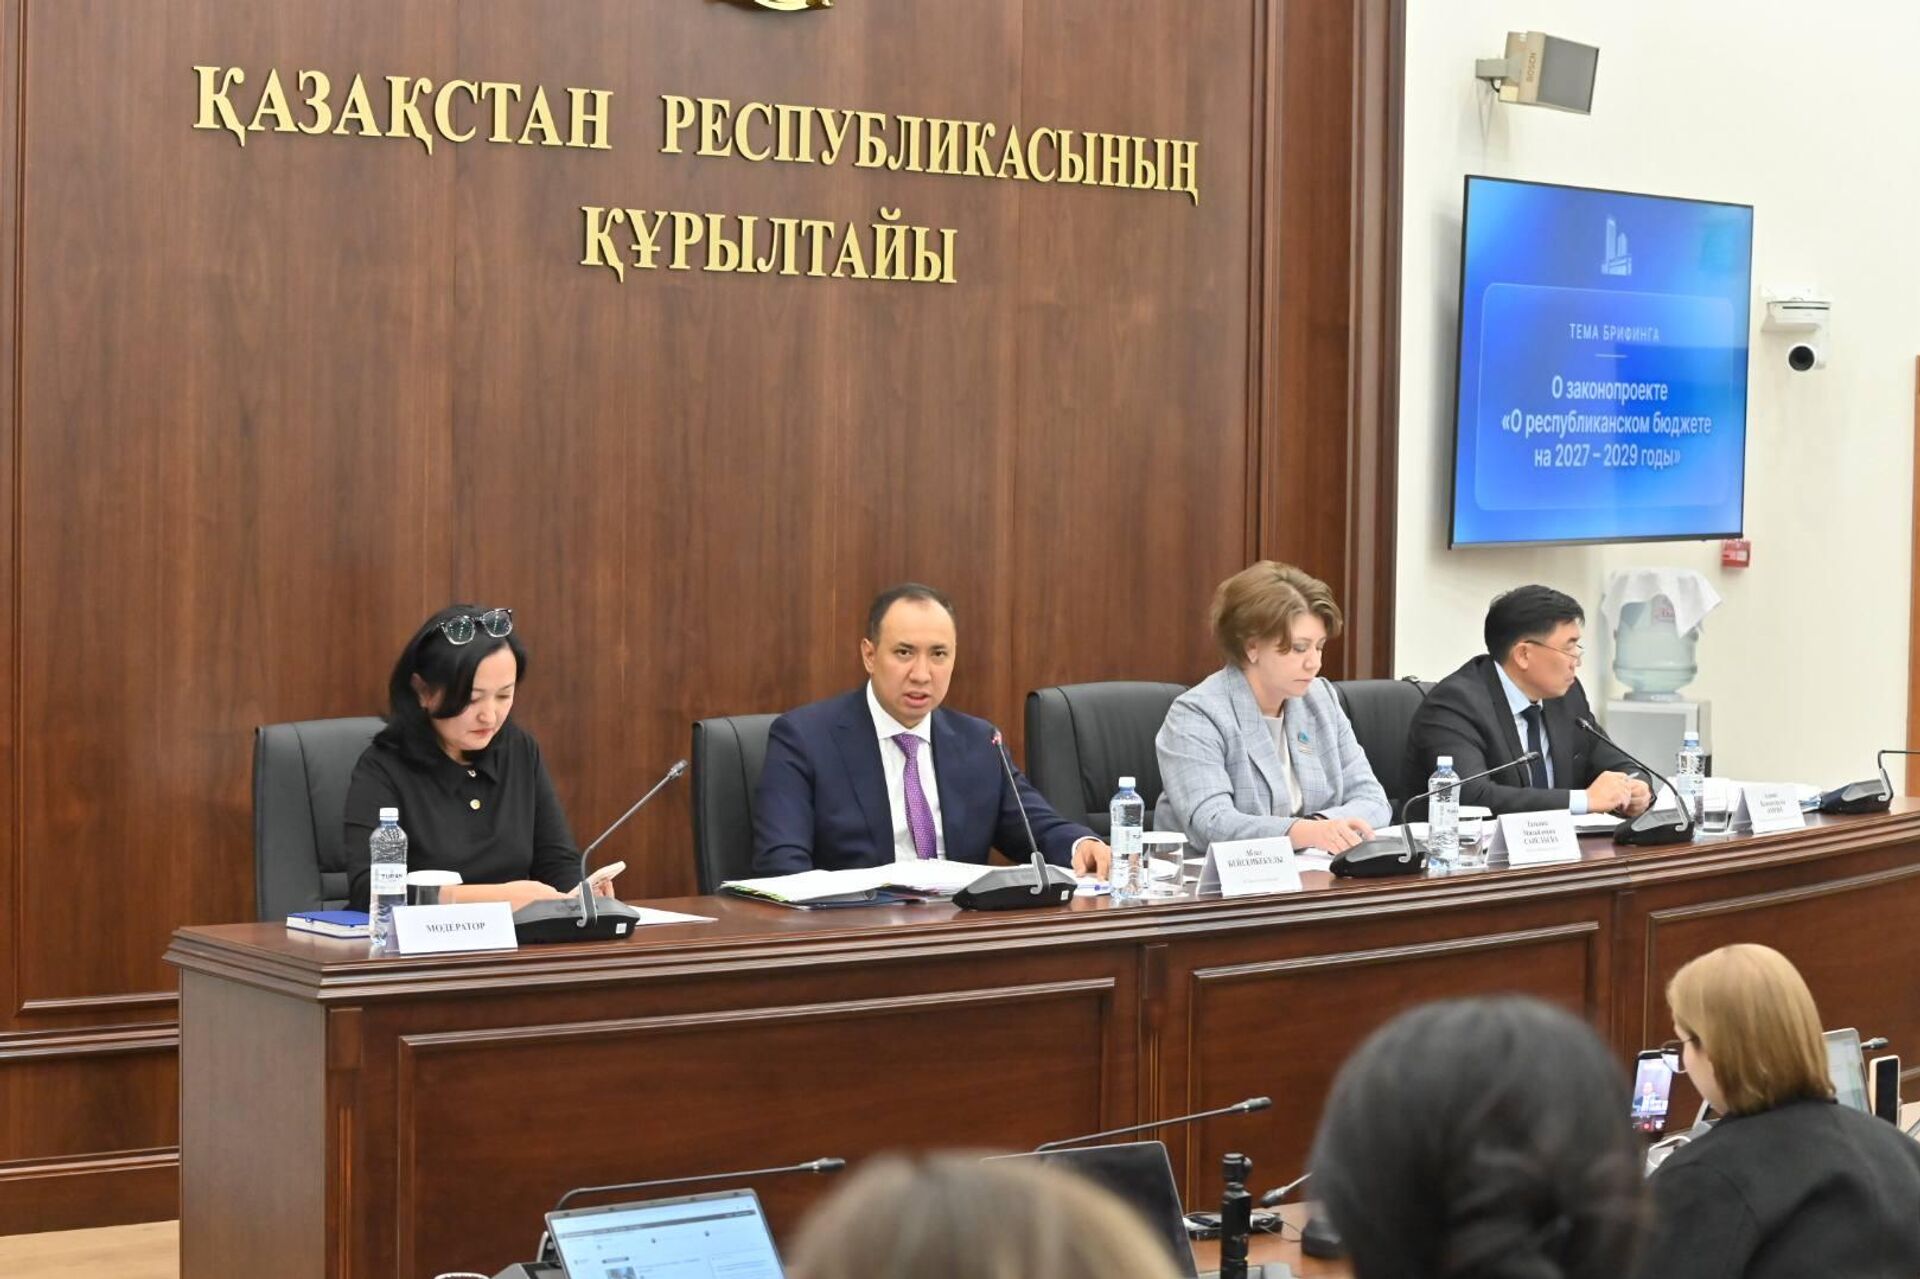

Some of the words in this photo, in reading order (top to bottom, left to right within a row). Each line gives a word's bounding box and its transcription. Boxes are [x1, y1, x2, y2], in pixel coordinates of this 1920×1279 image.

[193, 65, 614, 156] ҚАЗАҚСТАН
[660, 94, 1199, 206] РЕСПУБЛИКАСЫНЫҢ
[580, 206, 958, 285] ҚҰРЫЛТАЙЫ
[1569, 323, 1599, 340] ТЕМА
[1603, 324, 1660, 342] БРИФИНГА
[1552, 375, 1563, 399] О
[1566, 380, 1668, 406] законопроекте
[1502, 408, 1522, 433] «О
[1526, 410, 1650, 439] республиканском
[1653, 411, 1712, 438] бюджете
[1534, 448, 1551, 467] на
[1555, 443, 1590, 467] 2027
[1603, 443, 1638, 467] 2029
[1641, 448, 1681, 470] годы»
[426, 921, 485, 933] МОДЕРАТОР
